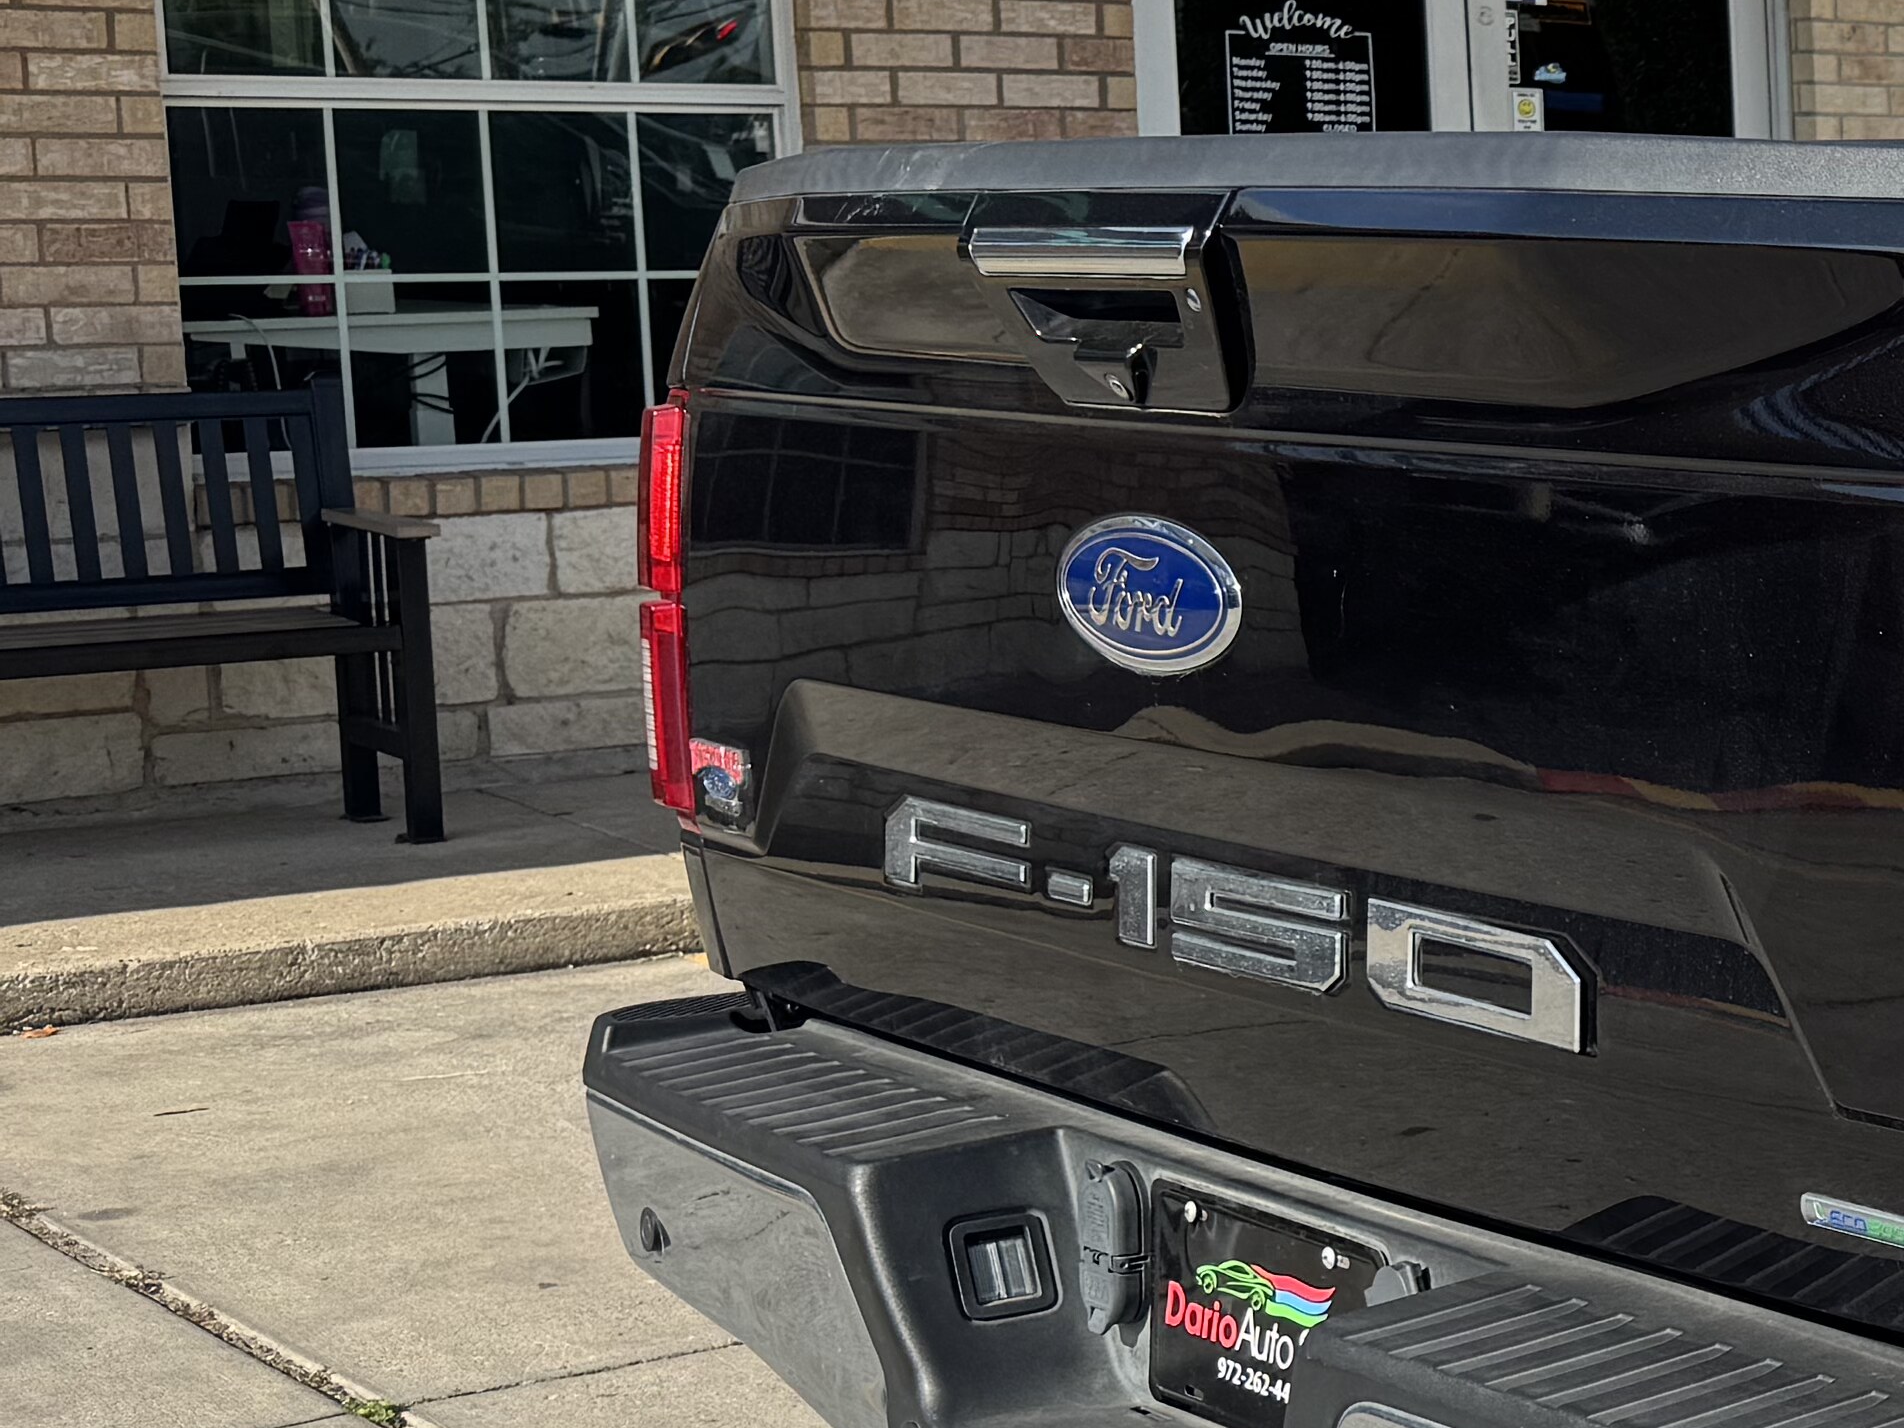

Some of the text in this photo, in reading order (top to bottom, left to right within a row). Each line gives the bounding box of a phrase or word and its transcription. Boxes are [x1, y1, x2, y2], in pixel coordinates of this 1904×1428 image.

[1239, 0, 1354, 39] Welcome
[1505, 16, 1517, 66] PULL
[1269, 42, 1330, 55] OPEN HOURS
[1232, 56, 1265, 68] Monday
[1232, 67, 1267, 79] Tuesday
[1233, 79, 1280, 90] Wednesday
[1233, 89, 1272, 101] Thursday
[1234, 100, 1260, 111] Friday
[1234, 110, 1272, 122] Saturday
[1235, 122, 1266, 132] Sunday
[1088, 547, 1184, 637] Ford
[884, 794, 1592, 1054] F-150
[1165, 1279, 1238, 1349] Dario
[1234, 1306, 1295, 1370] Auto
[1216, 1356, 1291, 1404] 972-262-44
